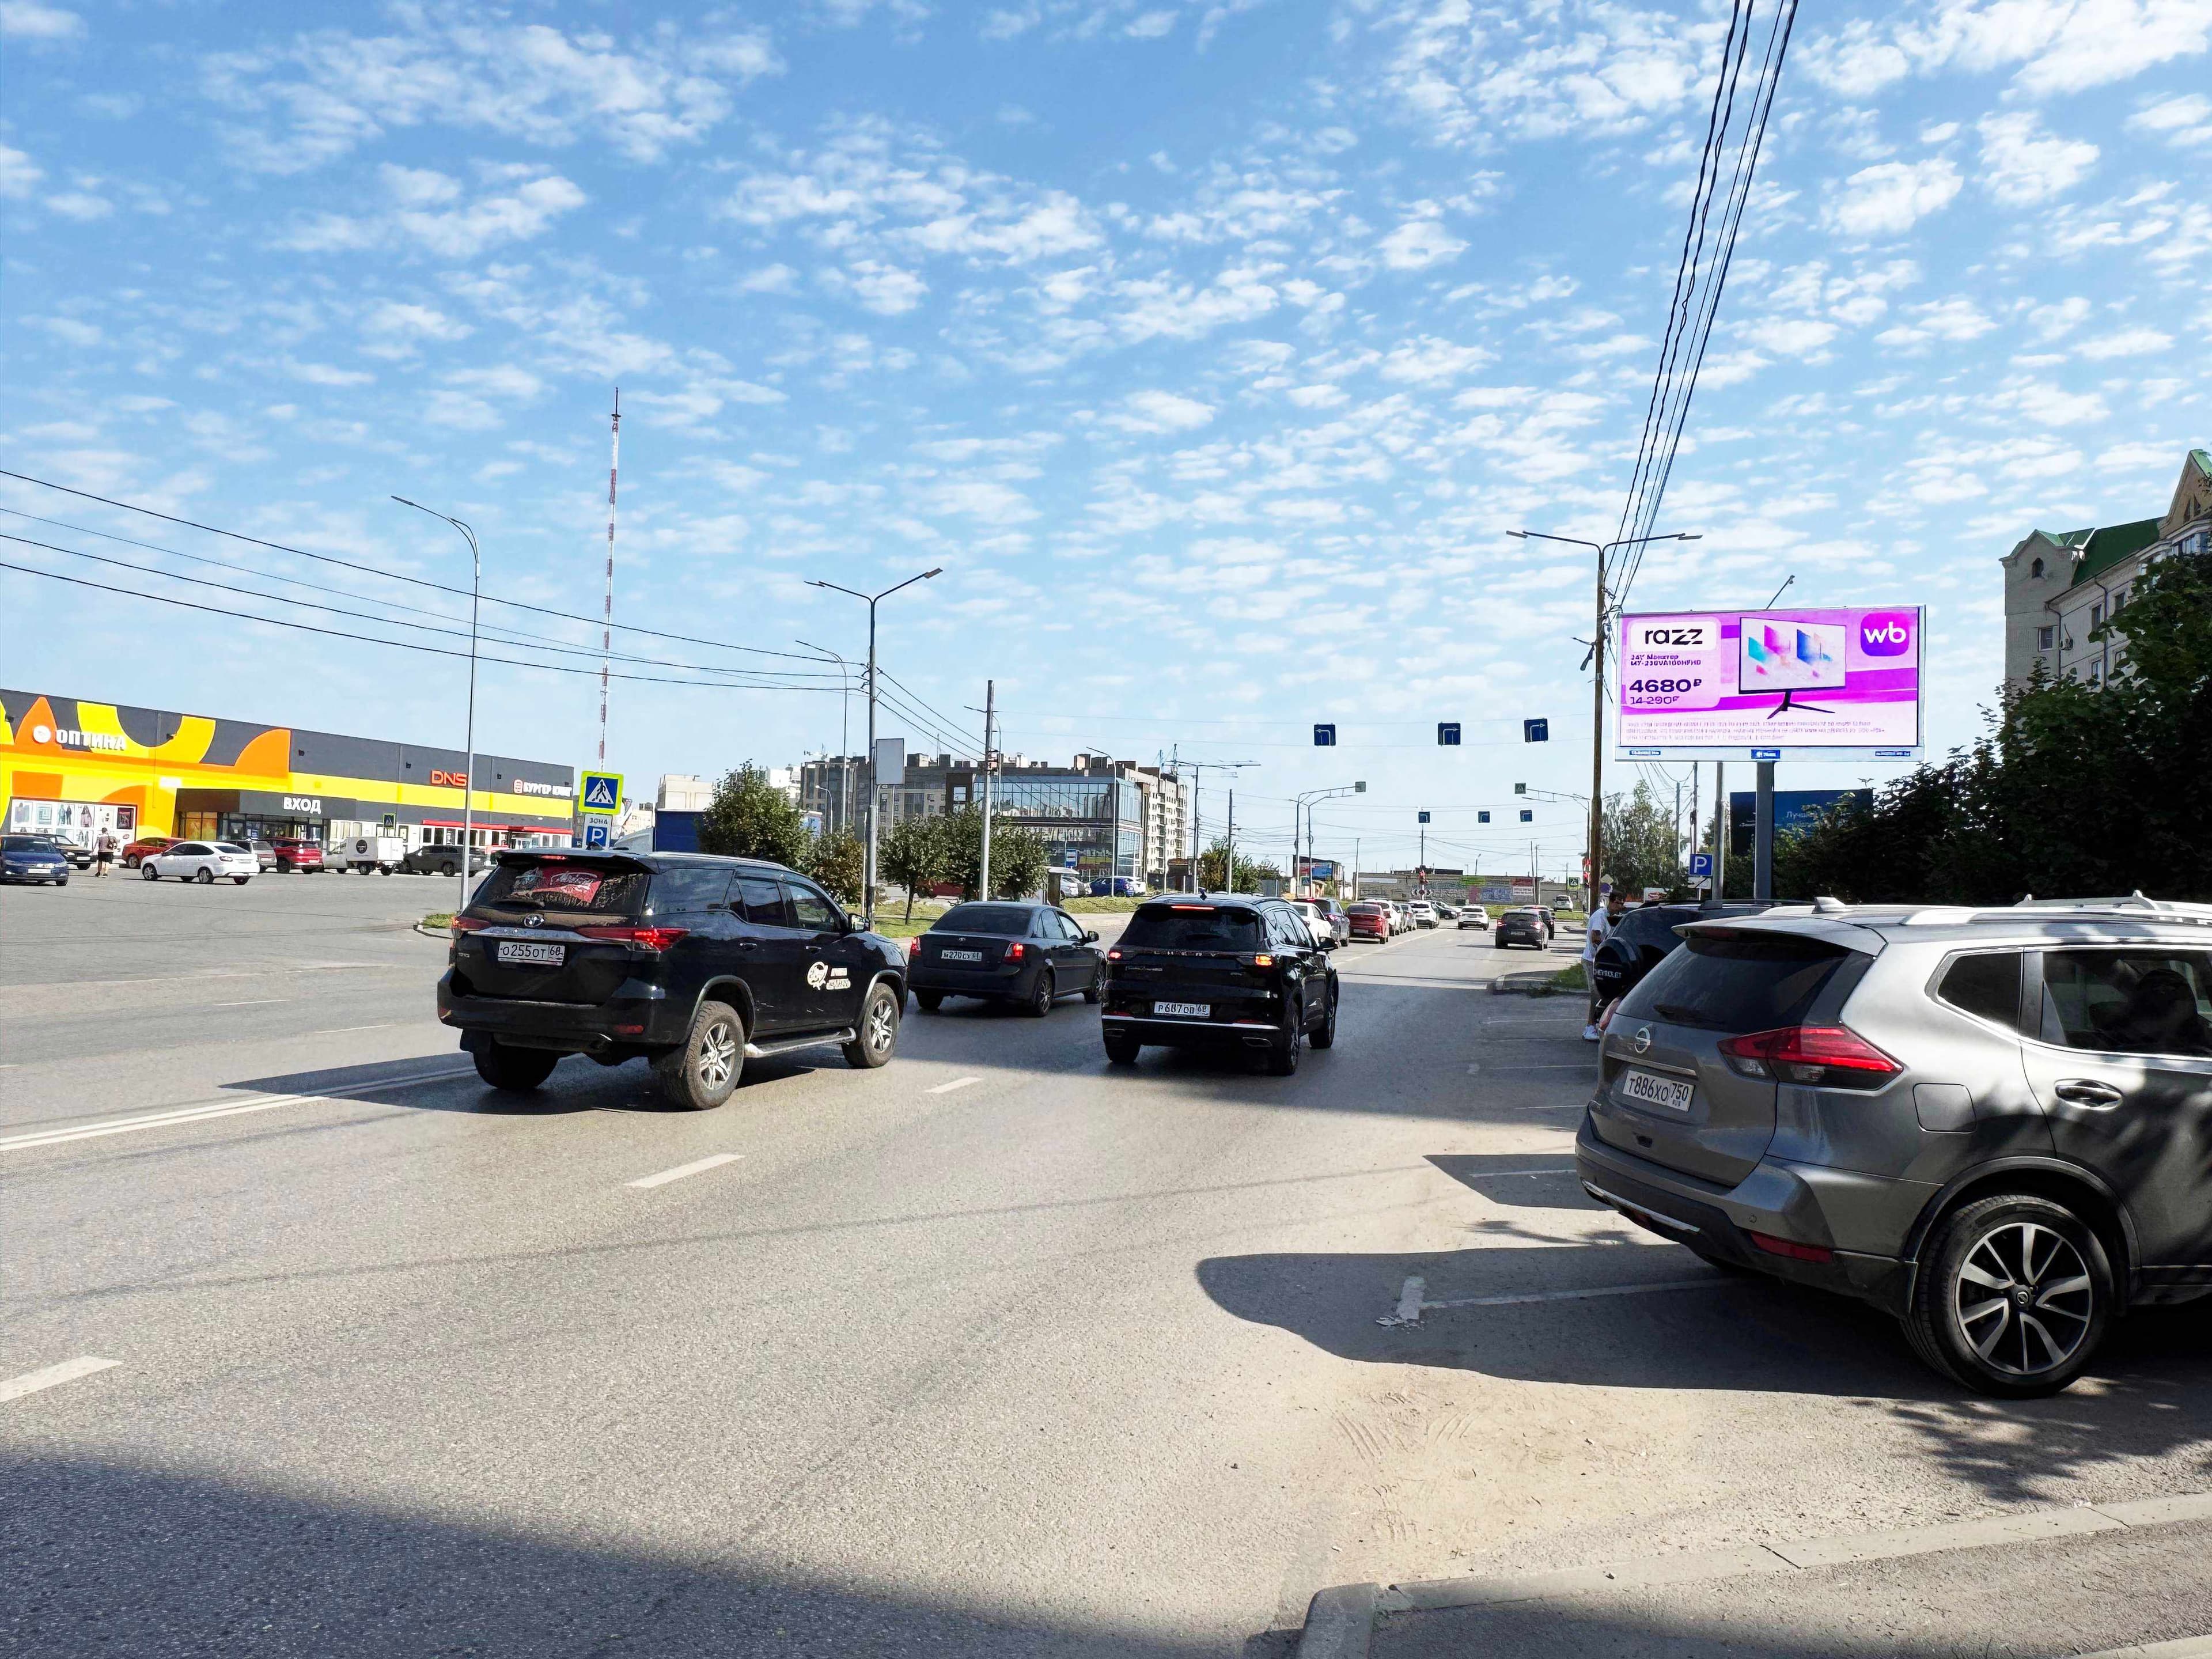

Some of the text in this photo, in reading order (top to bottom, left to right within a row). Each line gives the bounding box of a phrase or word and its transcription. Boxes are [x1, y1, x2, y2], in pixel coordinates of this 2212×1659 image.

[1645, 628, 1703, 645] razz
[1863, 622, 1906, 643] wb
[56, 729, 126, 751] ОПТИНА
[431, 770, 467, 786] DNS
[283, 796, 321, 815] ВХОД
[1694, 856, 1707, 873] P
[1628, 1075, 1689, 1101] Т886ХО 750
